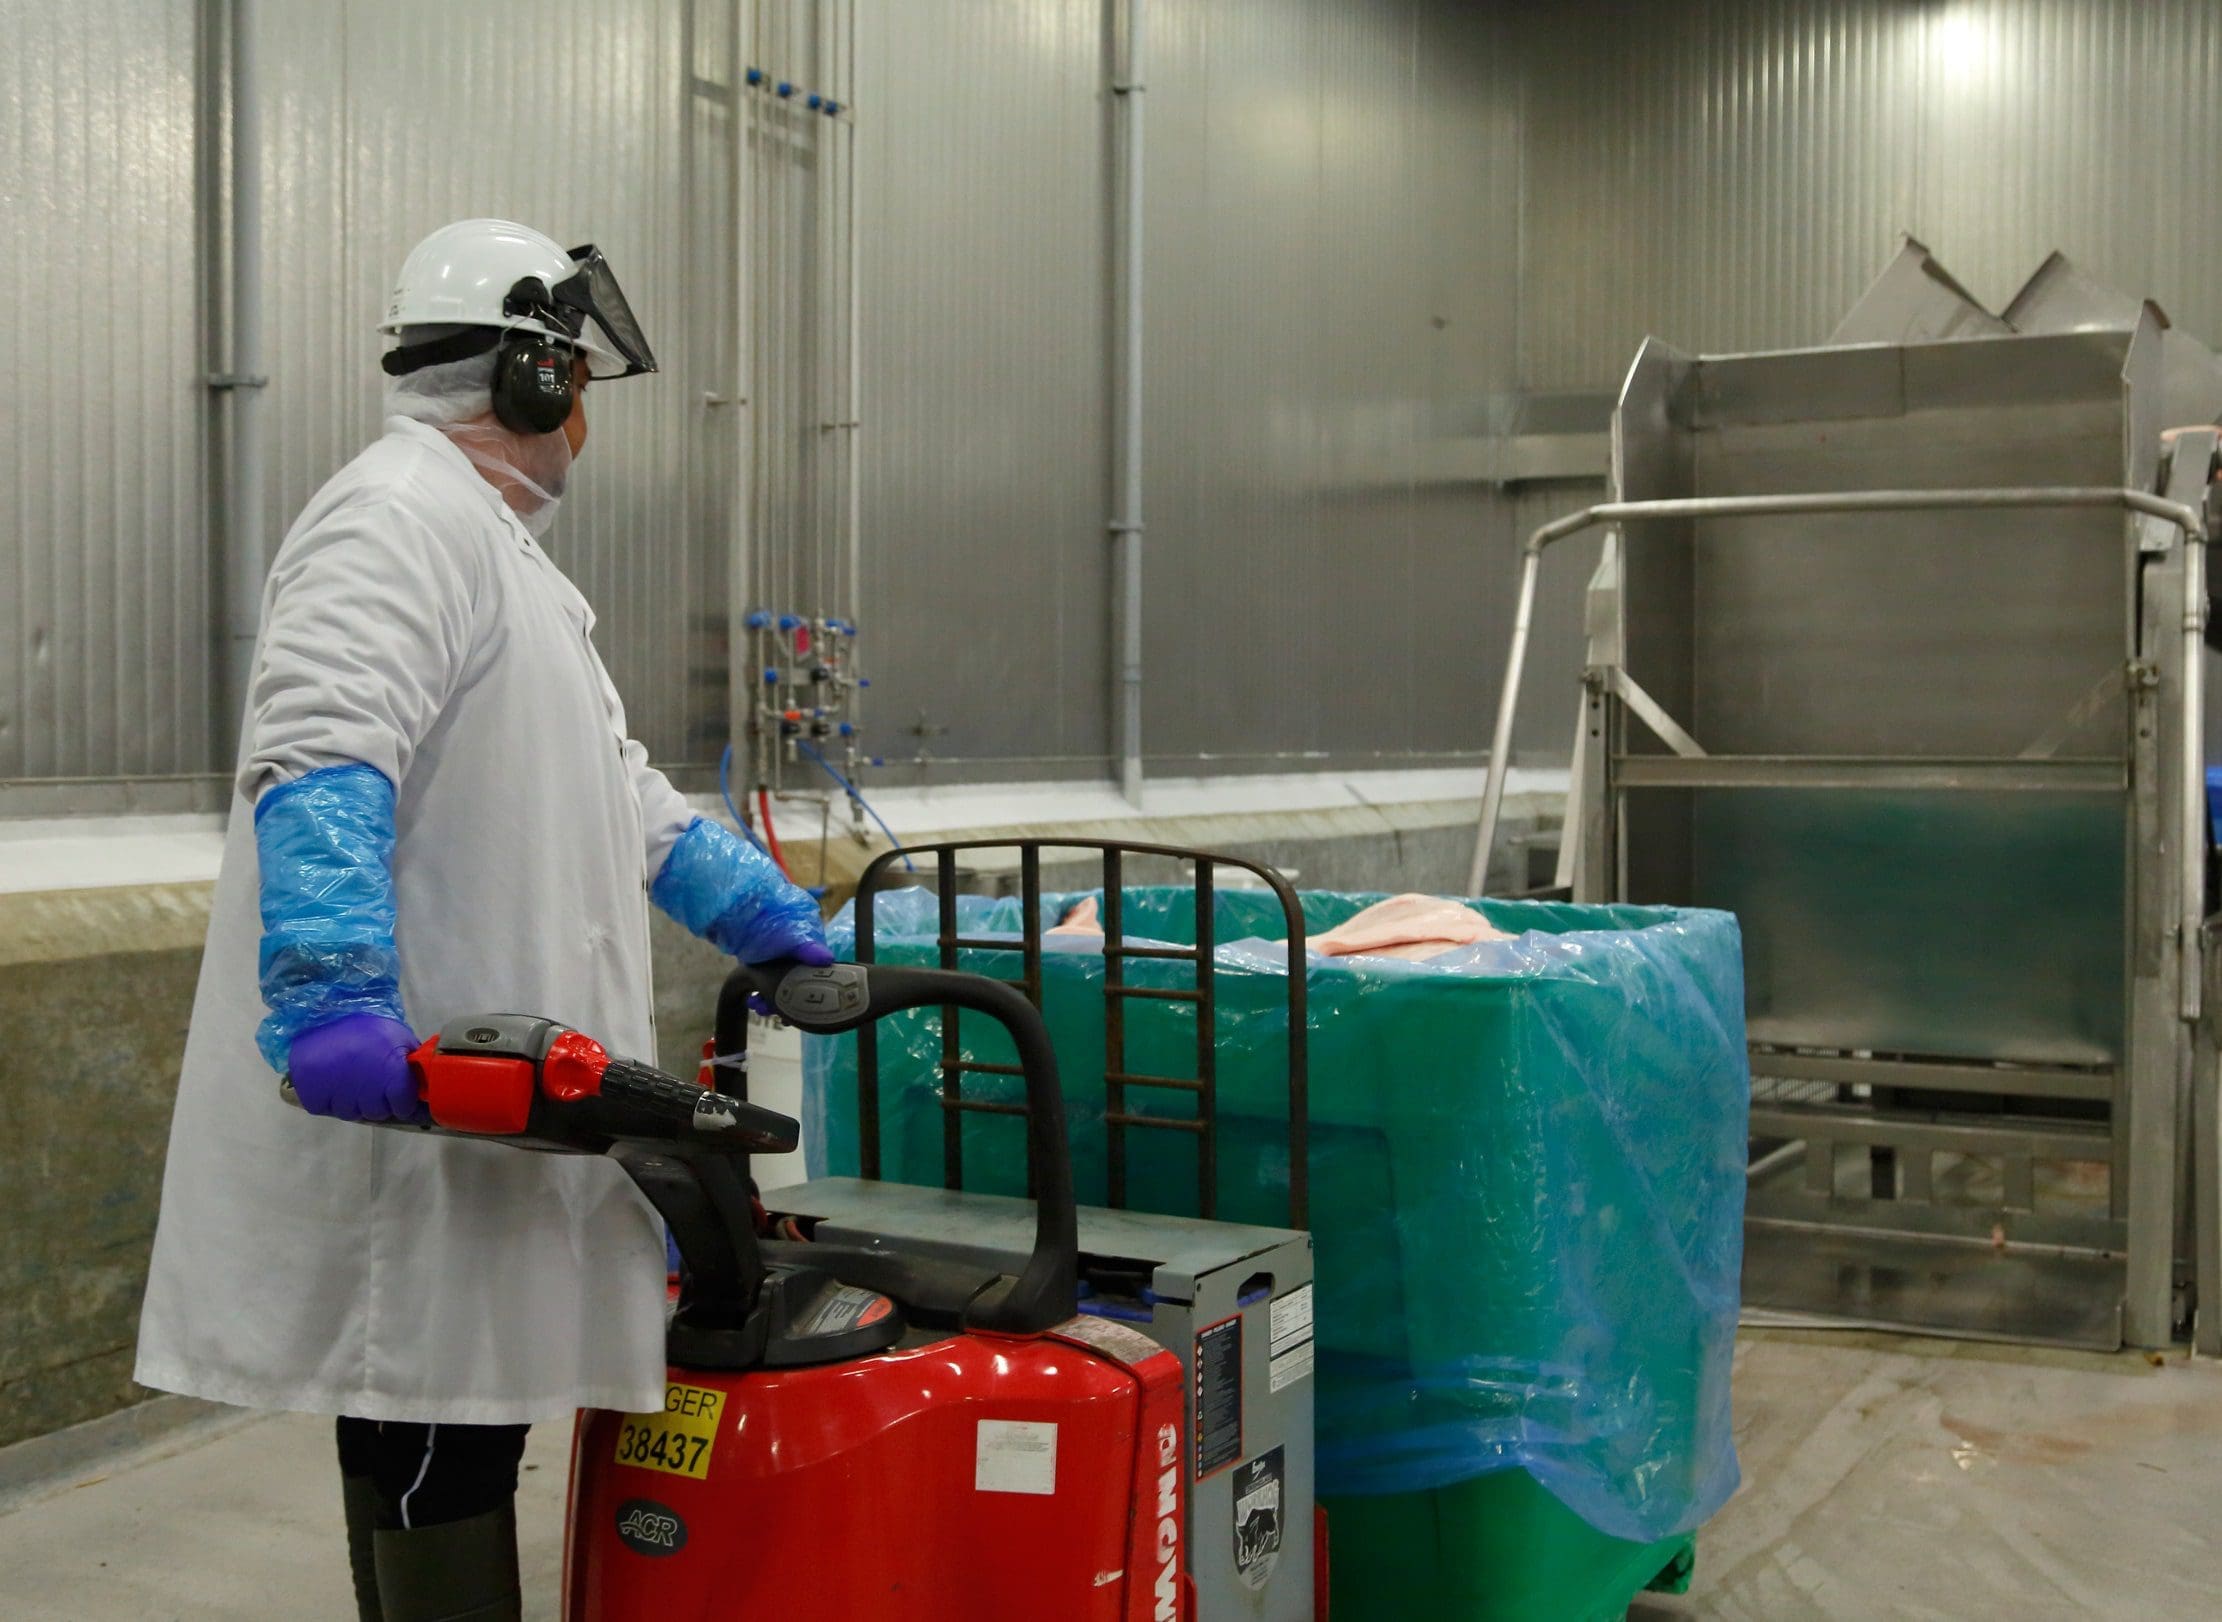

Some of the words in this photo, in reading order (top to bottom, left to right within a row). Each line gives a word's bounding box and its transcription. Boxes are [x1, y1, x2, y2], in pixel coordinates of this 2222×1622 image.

[664, 1386, 718, 1420] GER
[619, 1424, 710, 1473] 38437
[619, 1509, 678, 1547] ACR
[1154, 1422, 1178, 1622] MOND
